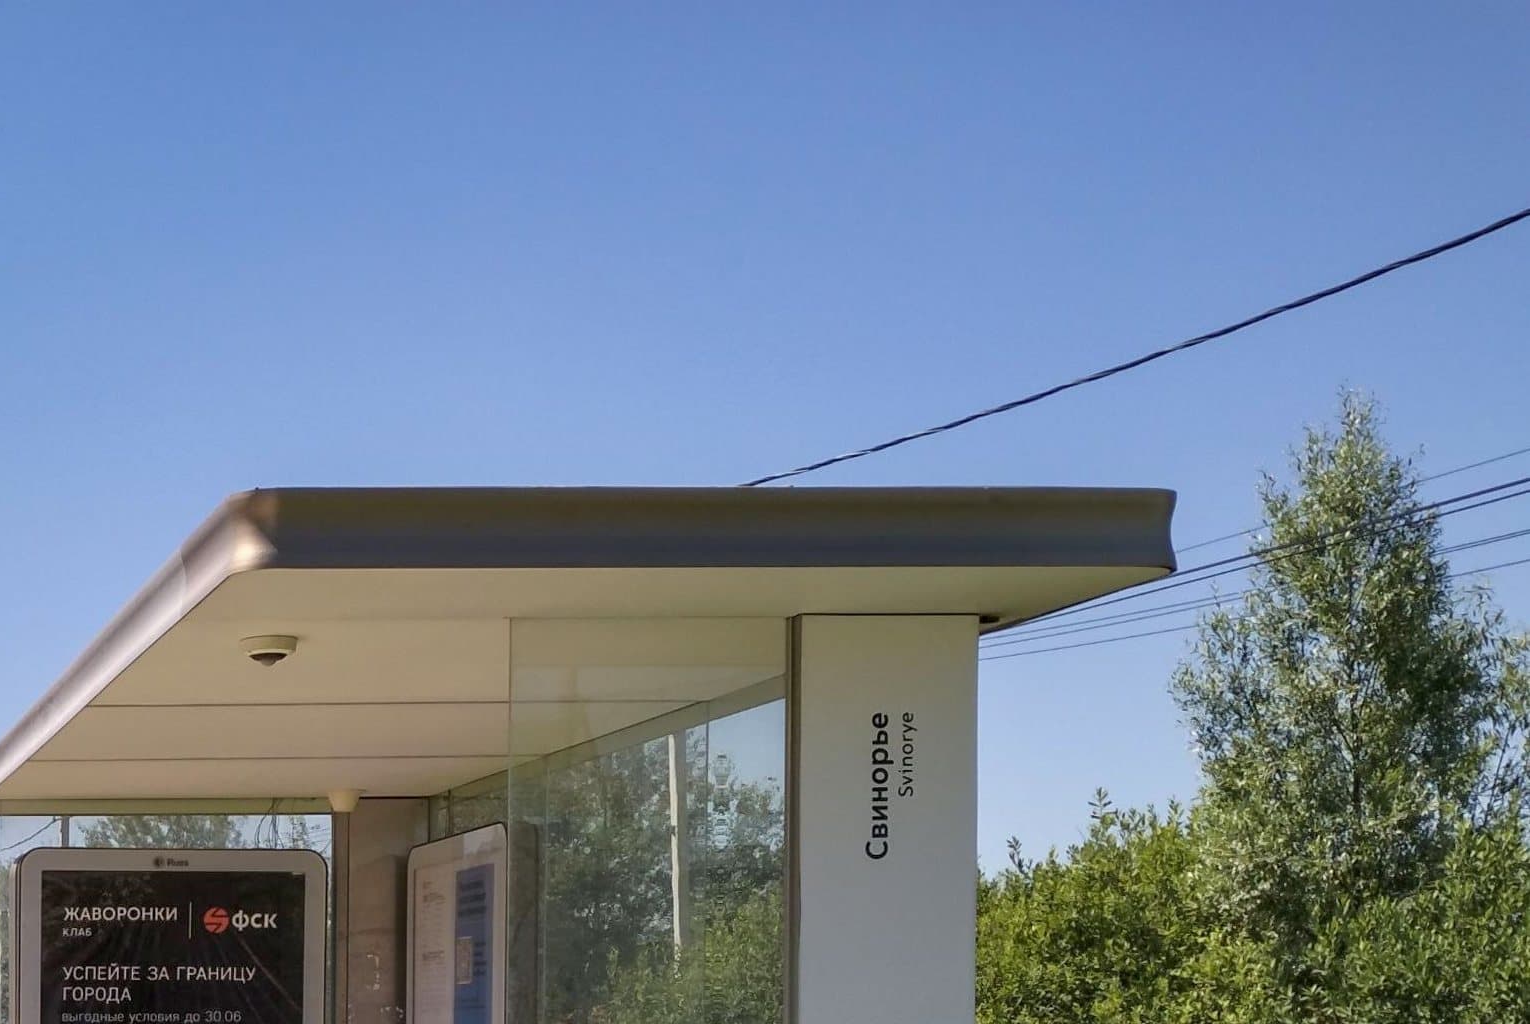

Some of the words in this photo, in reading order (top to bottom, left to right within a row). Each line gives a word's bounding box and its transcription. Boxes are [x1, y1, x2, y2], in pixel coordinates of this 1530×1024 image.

[898, 712, 917, 797] Svinorye
[865, 712, 894, 859] Свинорье
[64, 907, 177, 921] ЖАВОРОНКИ
[62, 928, 92, 937] КЛАБ
[63, 963, 141, 981] УСПЕЙТЕ
[147, 966, 169, 981] ЗА
[176, 967, 256, 984] ГРАНИЦУ
[62, 987, 132, 1004] ГОРОДА
[61, 1013, 124, 1023] выгодные
[129, 1013, 180, 1024] условия
[184, 1013, 200, 1024] до
